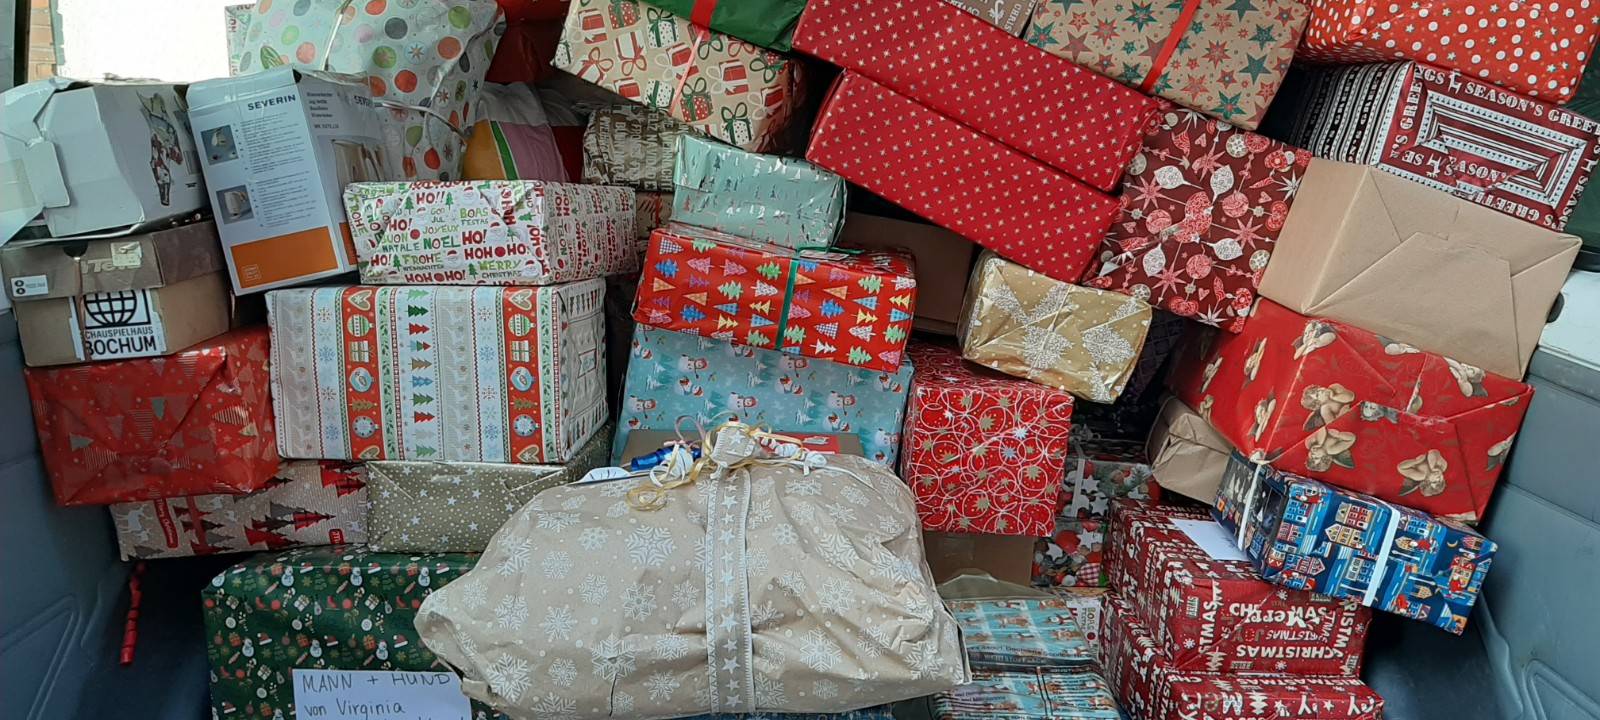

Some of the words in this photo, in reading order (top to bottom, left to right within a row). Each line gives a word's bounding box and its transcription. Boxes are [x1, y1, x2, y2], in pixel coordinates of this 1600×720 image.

[247, 94, 296, 111] SEVERIN
[1464, 82, 1544, 117] SEASON'S
[416, 191, 445, 205] HO!!
[460, 207, 489, 219] BOAS
[389, 218, 413, 232] HO!
[461, 218, 489, 226] FESTAS
[423, 224, 459, 235] JOYEUX
[423, 236, 461, 250] NOEL
[462, 229, 487, 246] HO!
[370, 254, 392, 267] HO!
[402, 252, 442, 265] FROHE
[479, 259, 522, 271] MERRY
[1236, 643, 1337, 660] CHRISTMAS
[302, 673, 352, 693] MANN
[367, 675, 379, 686] +
[392, 673, 451, 686] HUND
[304, 704, 327, 717] von
[335, 698, 406, 720] Virginia
